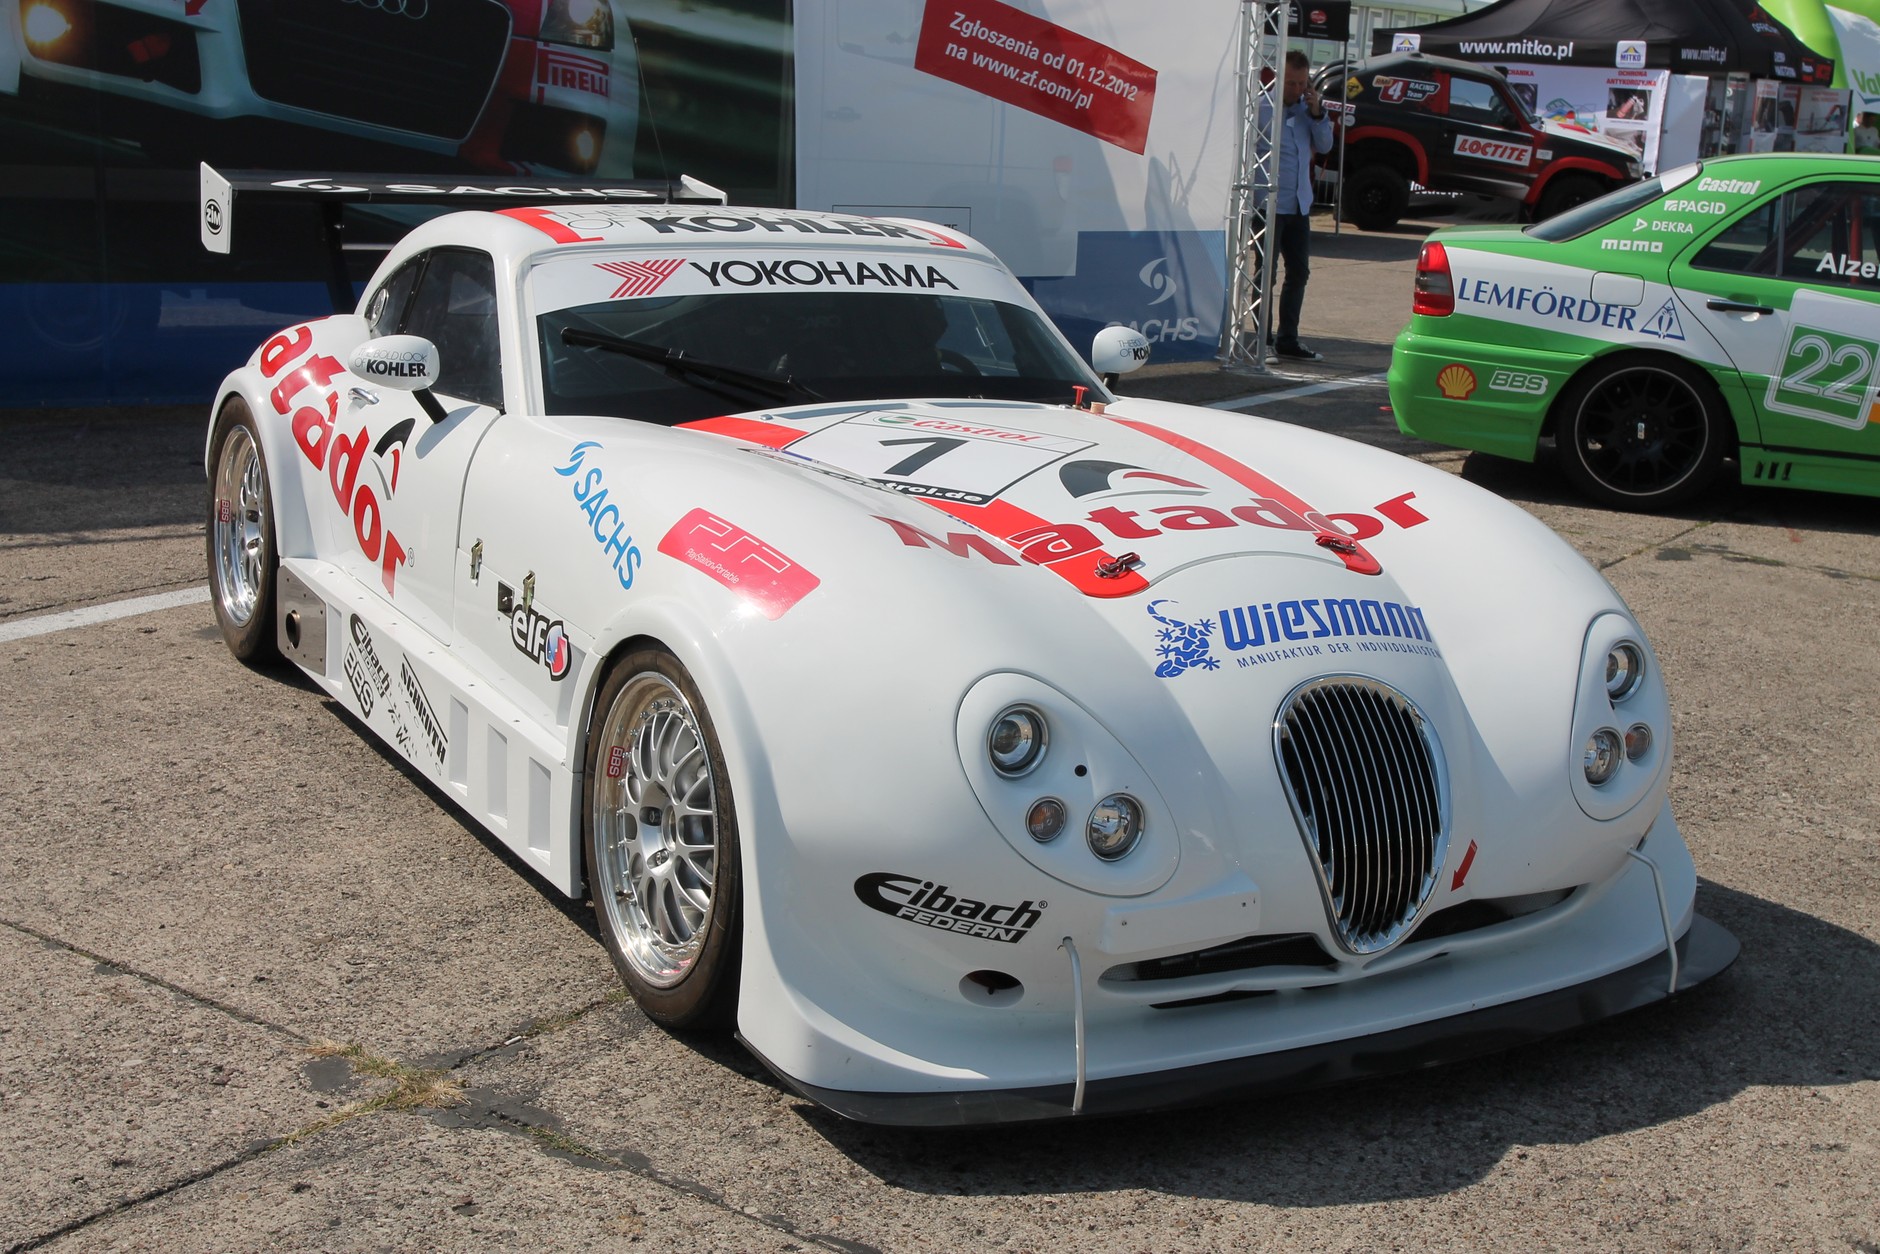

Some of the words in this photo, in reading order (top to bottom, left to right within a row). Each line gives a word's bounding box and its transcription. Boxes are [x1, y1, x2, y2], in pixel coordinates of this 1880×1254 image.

[949, 11, 1041, 61] Zgłoszenia
[1042, 53, 1066, 70] od
[1066, 57, 1139, 102] 01.12.2012
[1459, 39, 1574, 61] www.mitko.pl
[1620, 53, 1642, 62] MITKO
[537, 49, 609, 98] PIRELLI
[945, 41, 966, 61] na
[972, 51, 1094, 110] www.zf.com/pl
[1508, 69, 1535, 77] CHANIKA
[1387, 82, 1404, 99] 4
[1406, 90, 1424, 99] Team
[1408, 82, 1436, 92] RACING
[1457, 138, 1528, 163] LOCTITE
[385, 184, 658, 198] SACHS
[1697, 177, 1762, 196] Castrol
[1677, 201, 1727, 215] PAGID
[637, 216, 930, 242] KOHLER
[1651, 220, 1694, 234] DEKRA
[1601, 238, 1664, 253] momo
[689, 259, 961, 291] YOKOHAMA
[1457, 277, 1637, 332] LEMFÖRDER
[354, 357, 367, 368] OF
[366, 358, 427, 378] KOHLER
[373, 350, 399, 360] BOLD
[400, 352, 428, 363] LOOK
[1489, 370, 1549, 395] BBS
[1780, 334, 1873, 406] 22
[912, 420, 1043, 443] Castrol
[573, 467, 642, 591] SACHS
[869, 491, 1431, 567] Matador
[688, 516, 792, 574] PSP
[512, 608, 549, 662] elf
[350, 612, 391, 694] Eibach
[1236, 644, 1323, 669] MANUFAKTUR
[1328, 642, 1351, 655] DER
[343, 642, 374, 719] BBS
[608, 746, 623, 778] BBS
[853, 871, 1042, 930] Eibach
[896, 906, 1018, 942] FEDERN
